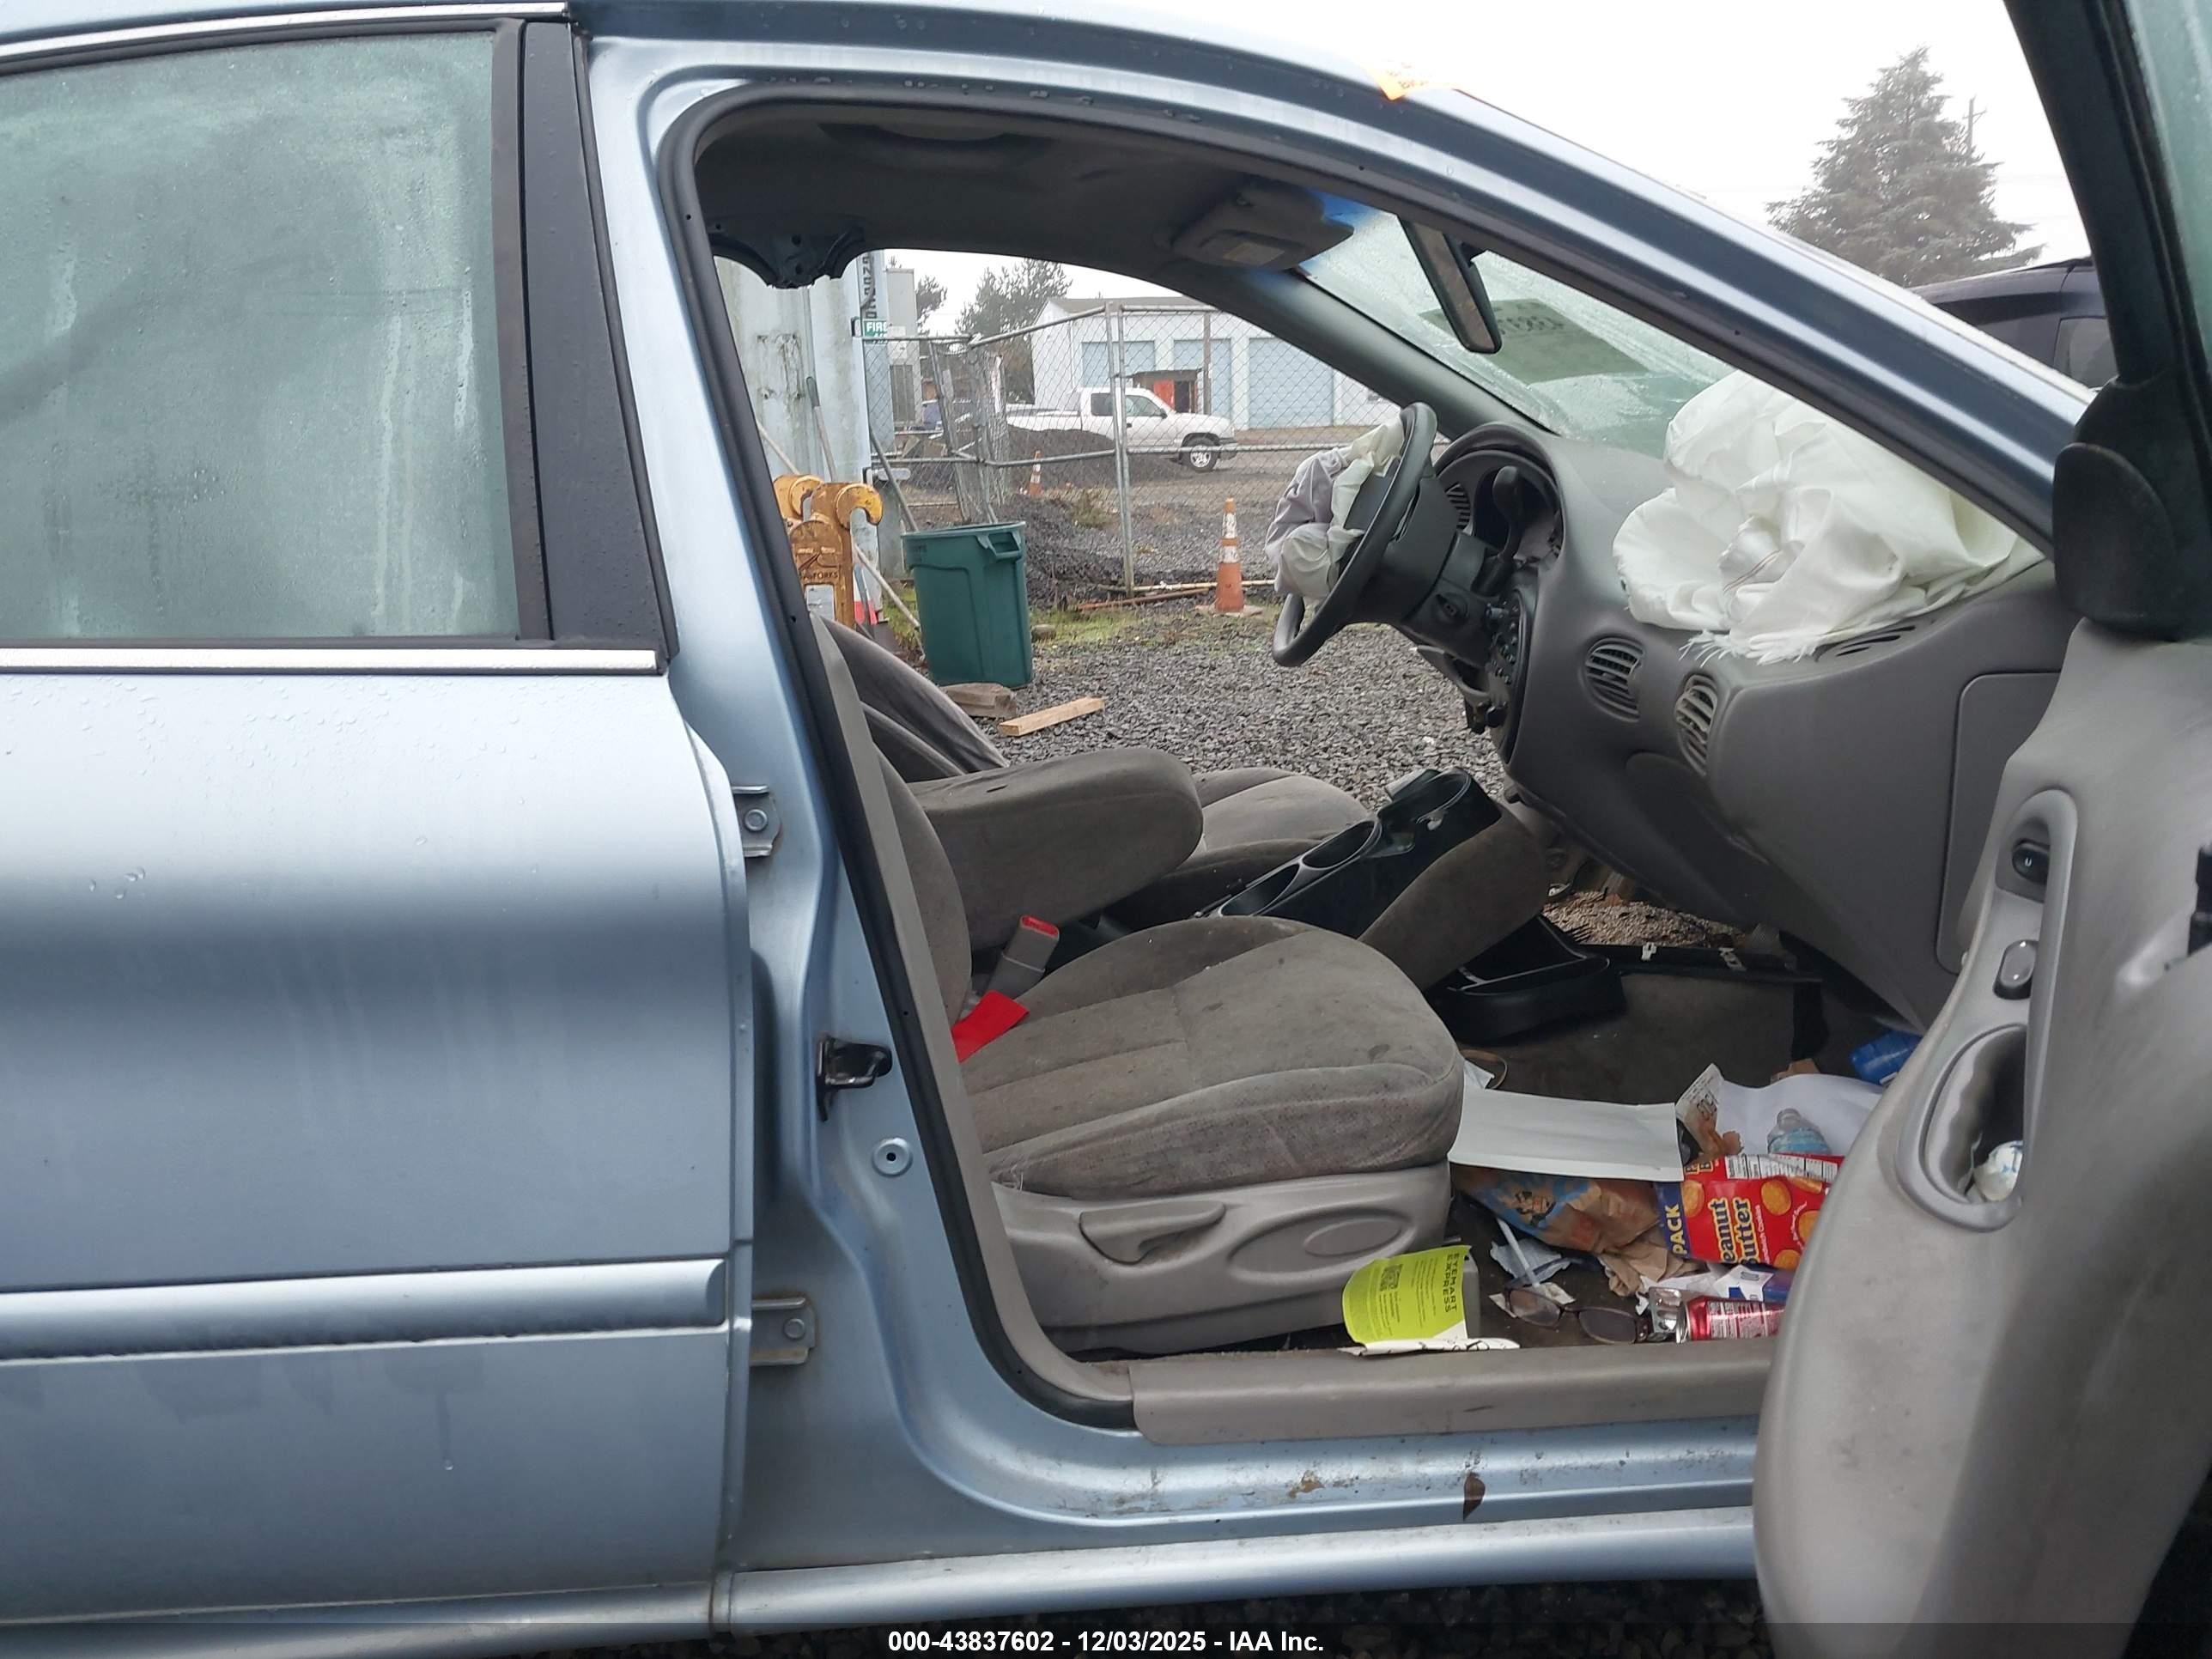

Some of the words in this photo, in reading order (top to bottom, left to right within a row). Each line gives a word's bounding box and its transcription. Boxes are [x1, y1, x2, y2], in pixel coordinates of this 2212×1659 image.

[1664, 1204, 1688, 1255] PACK
[1710, 1199, 1735, 1263] eanut
[1443, 1253, 1453, 1313] EXPRESS
[1450, 1253, 1460, 1311] EYEMART
